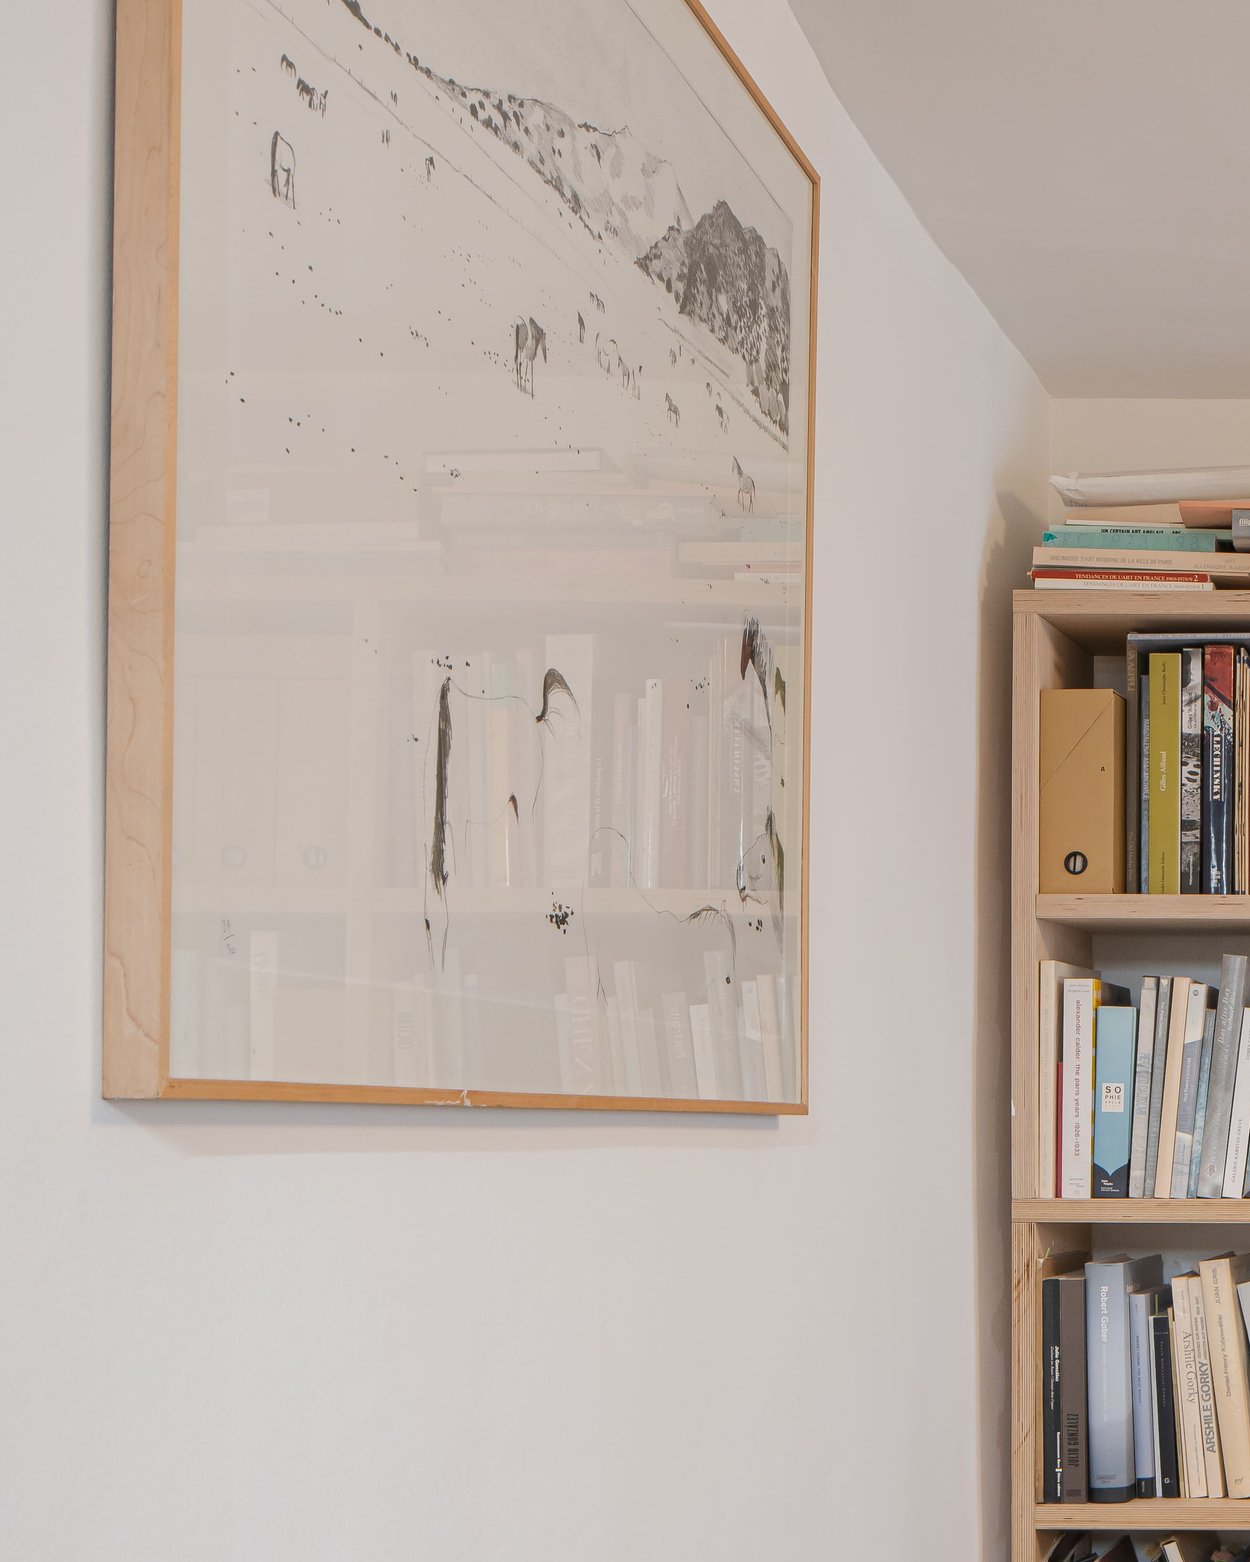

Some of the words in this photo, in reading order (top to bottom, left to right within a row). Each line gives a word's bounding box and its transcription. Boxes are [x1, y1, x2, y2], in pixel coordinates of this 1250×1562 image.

[1159, 774, 1167, 791] Gilles
[1182, 1331, 1194, 1369] Arshile
[1186, 1372, 1196, 1403] Gorky
[1198, 1361, 1211, 1402] GORKY
[1065, 1413, 1079, 1446] GONZÁLEZ
[1201, 1403, 1215, 1453] ARSHILE
[1067, 1448, 1079, 1467] JULIO
